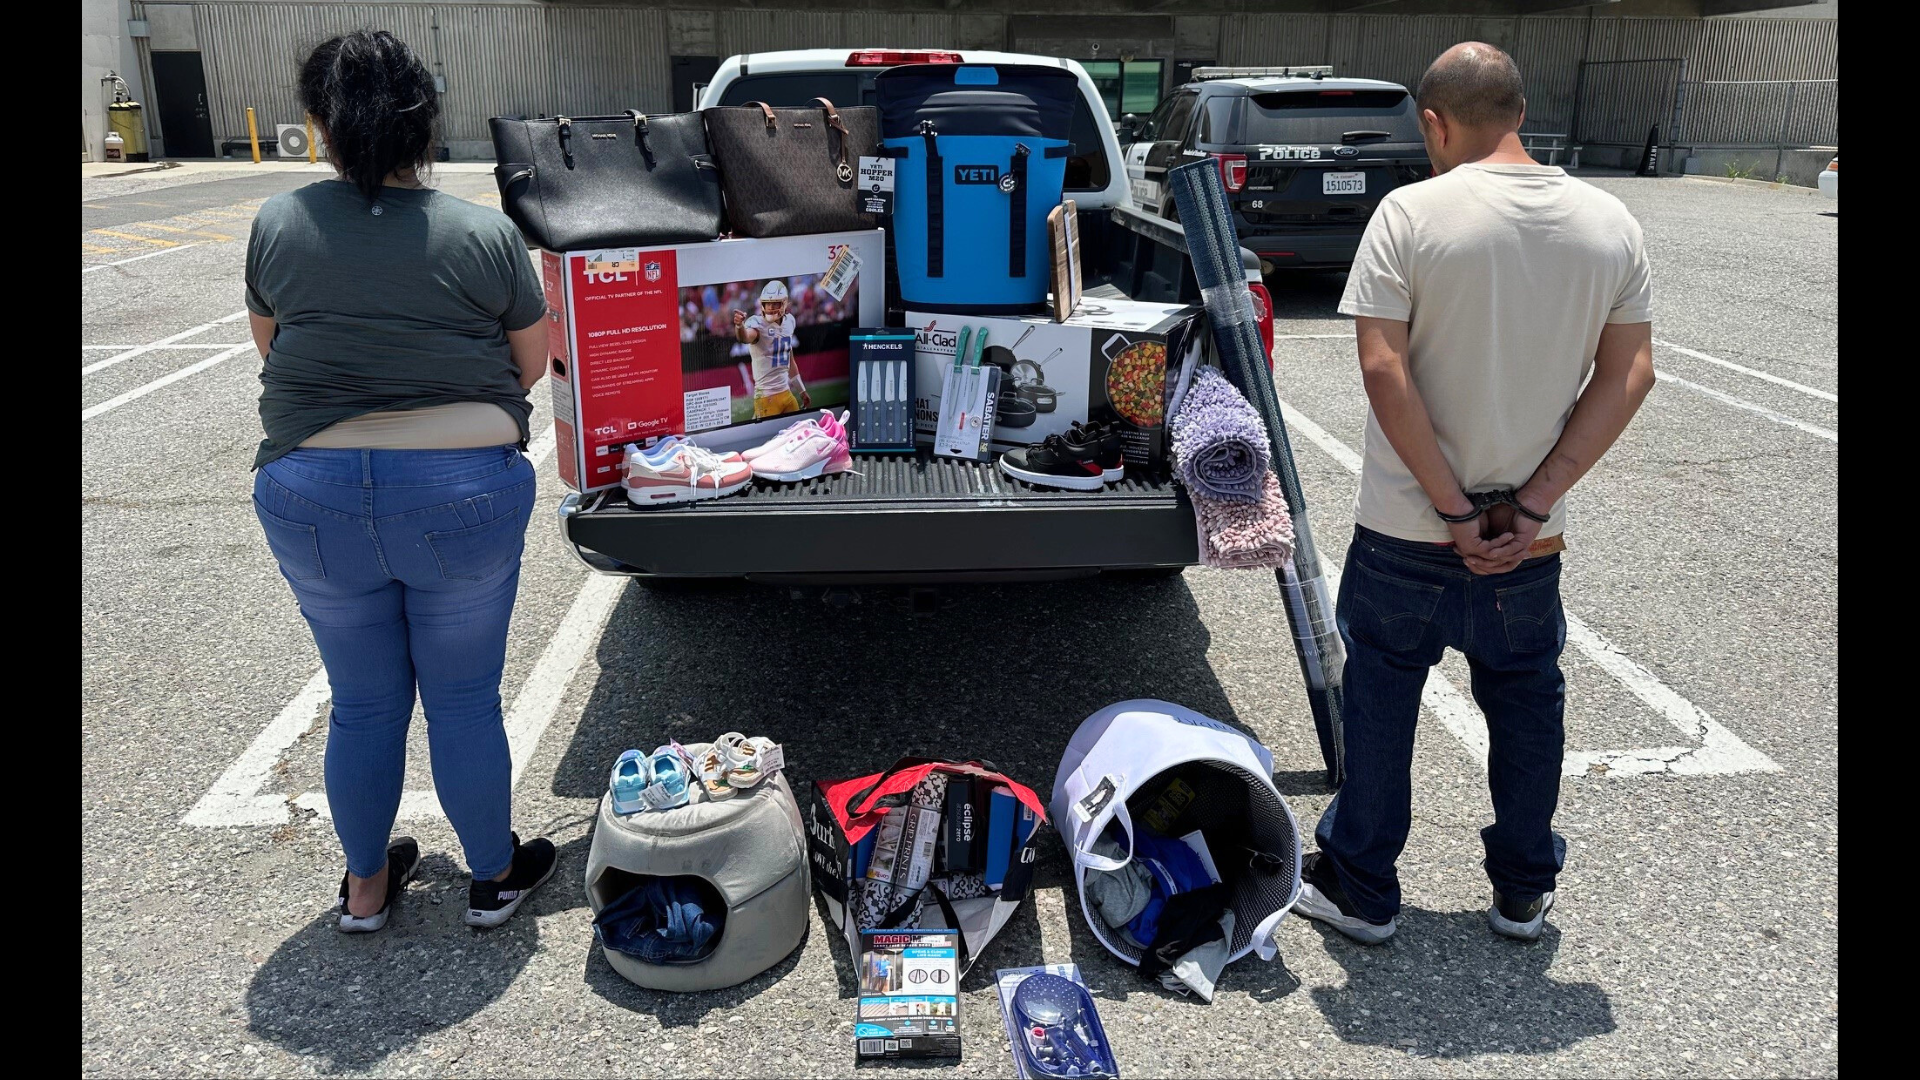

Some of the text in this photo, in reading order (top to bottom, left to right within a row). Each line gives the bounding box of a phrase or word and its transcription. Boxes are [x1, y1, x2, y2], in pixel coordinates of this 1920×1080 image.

[1258, 147, 1321, 160] POLICE
[860, 168, 893, 177] HOPPER
[958, 169, 995, 181] YETI
[1325, 180, 1363, 192] 1510573
[1252, 200, 1263, 208] 68
[583, 270, 628, 284] TCL
[646, 269, 660, 280] NFL
[631, 324, 667, 333] RESOLUTION
[981, 391, 995, 440] SABATIER
[638, 416, 669, 429] Google TV
[594, 425, 618, 436] TCL
[962, 803, 974, 842] eclipse
[900, 813, 917, 879] GRIP PRINTS
[873, 934, 911, 944] MAGIC
